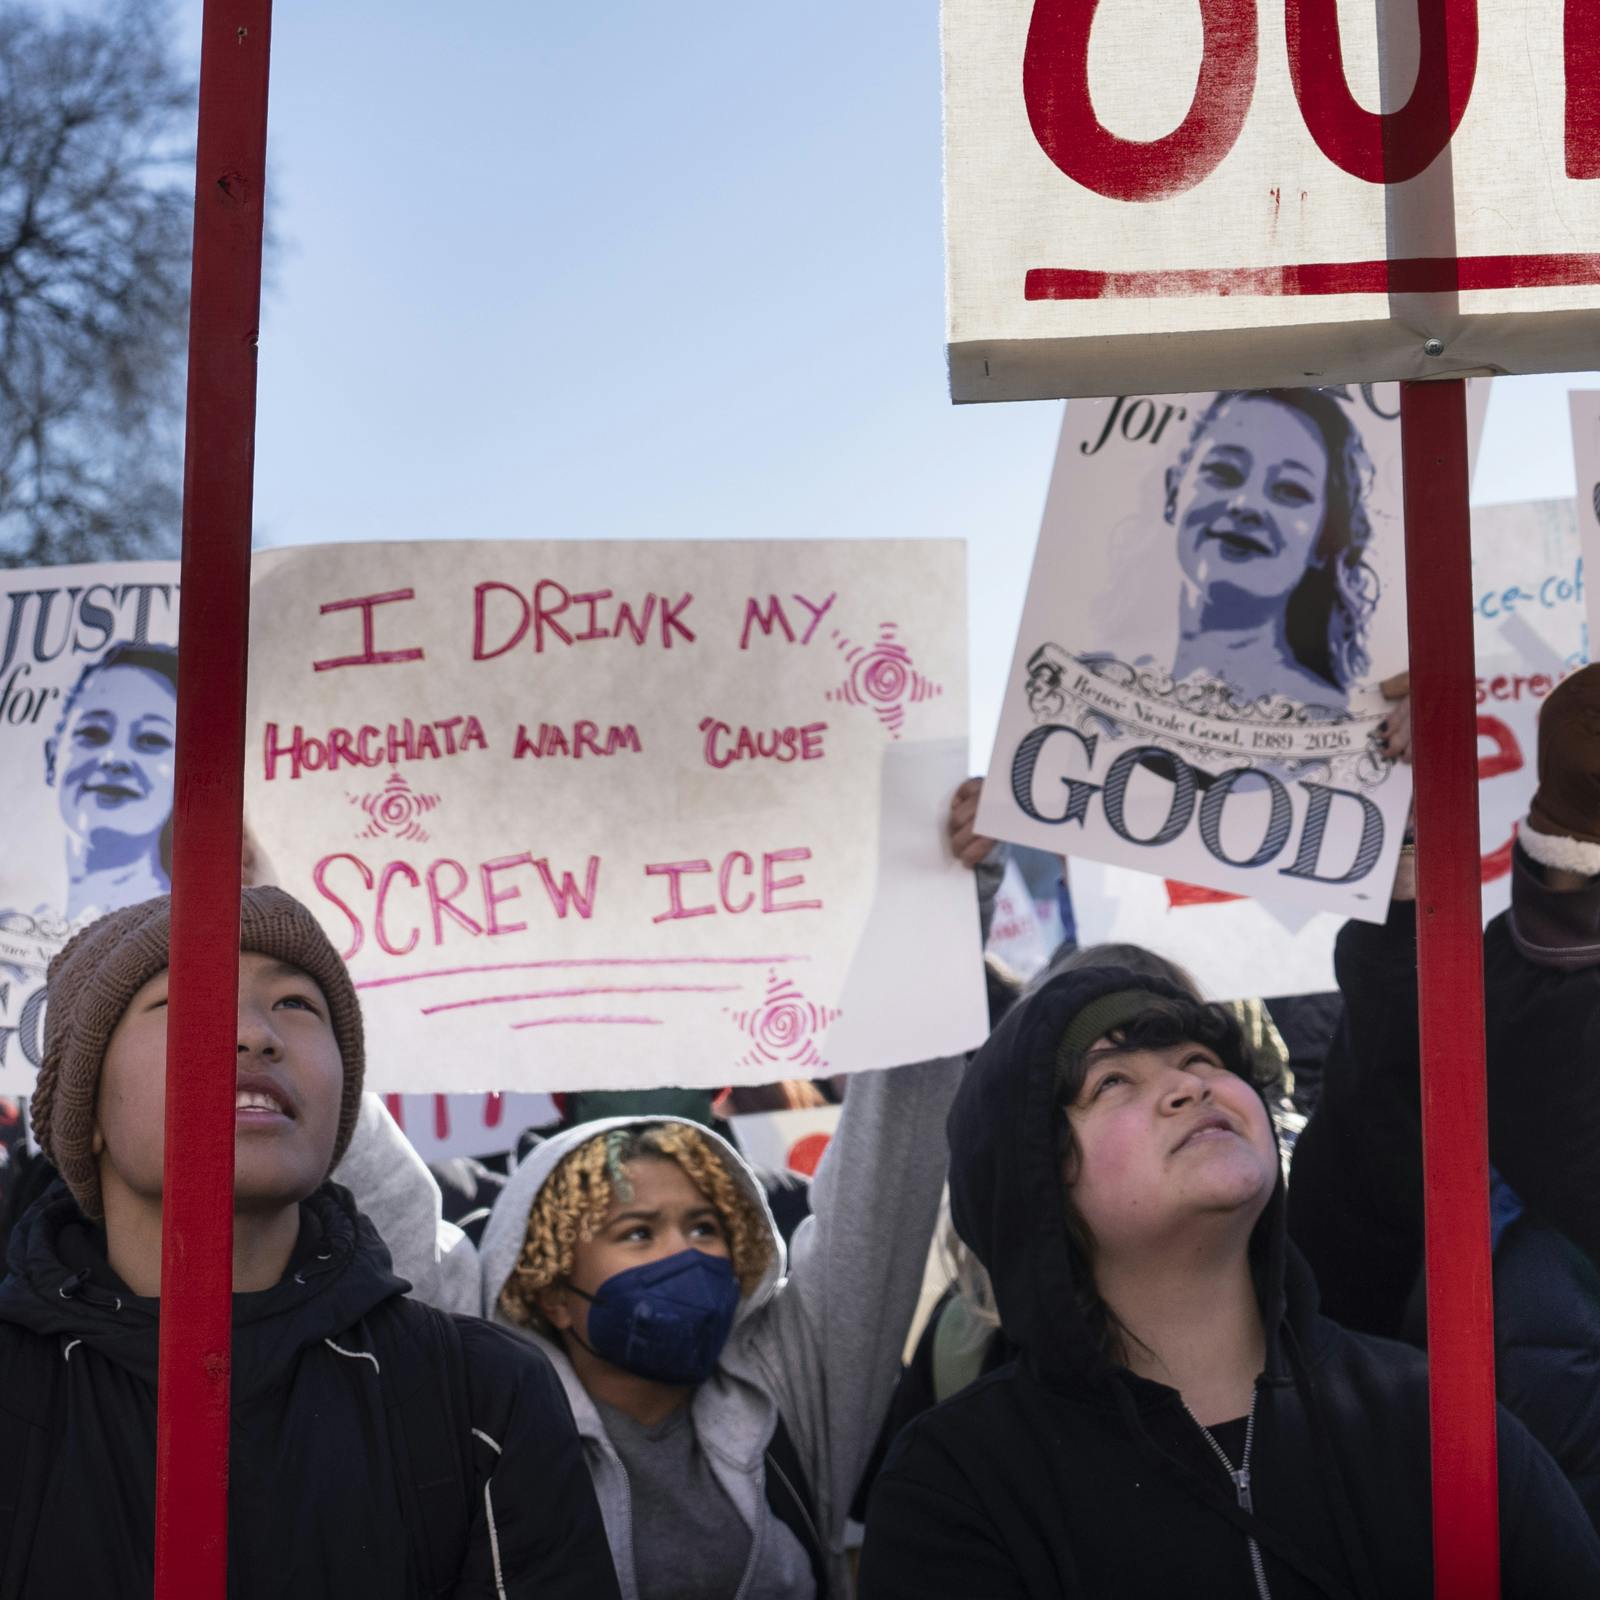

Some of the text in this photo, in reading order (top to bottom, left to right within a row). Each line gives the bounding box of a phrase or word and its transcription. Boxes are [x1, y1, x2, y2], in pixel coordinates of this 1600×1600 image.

[312, 580, 836, 672] I DRINK MY
[263, 715, 488, 781] HORCHATA
[513, 723, 643, 760] WARM
[1132, 701, 1187, 732] Nicole
[1011, 723, 1386, 885] GOOD
[312, 846, 823, 961] SCREW ICE
